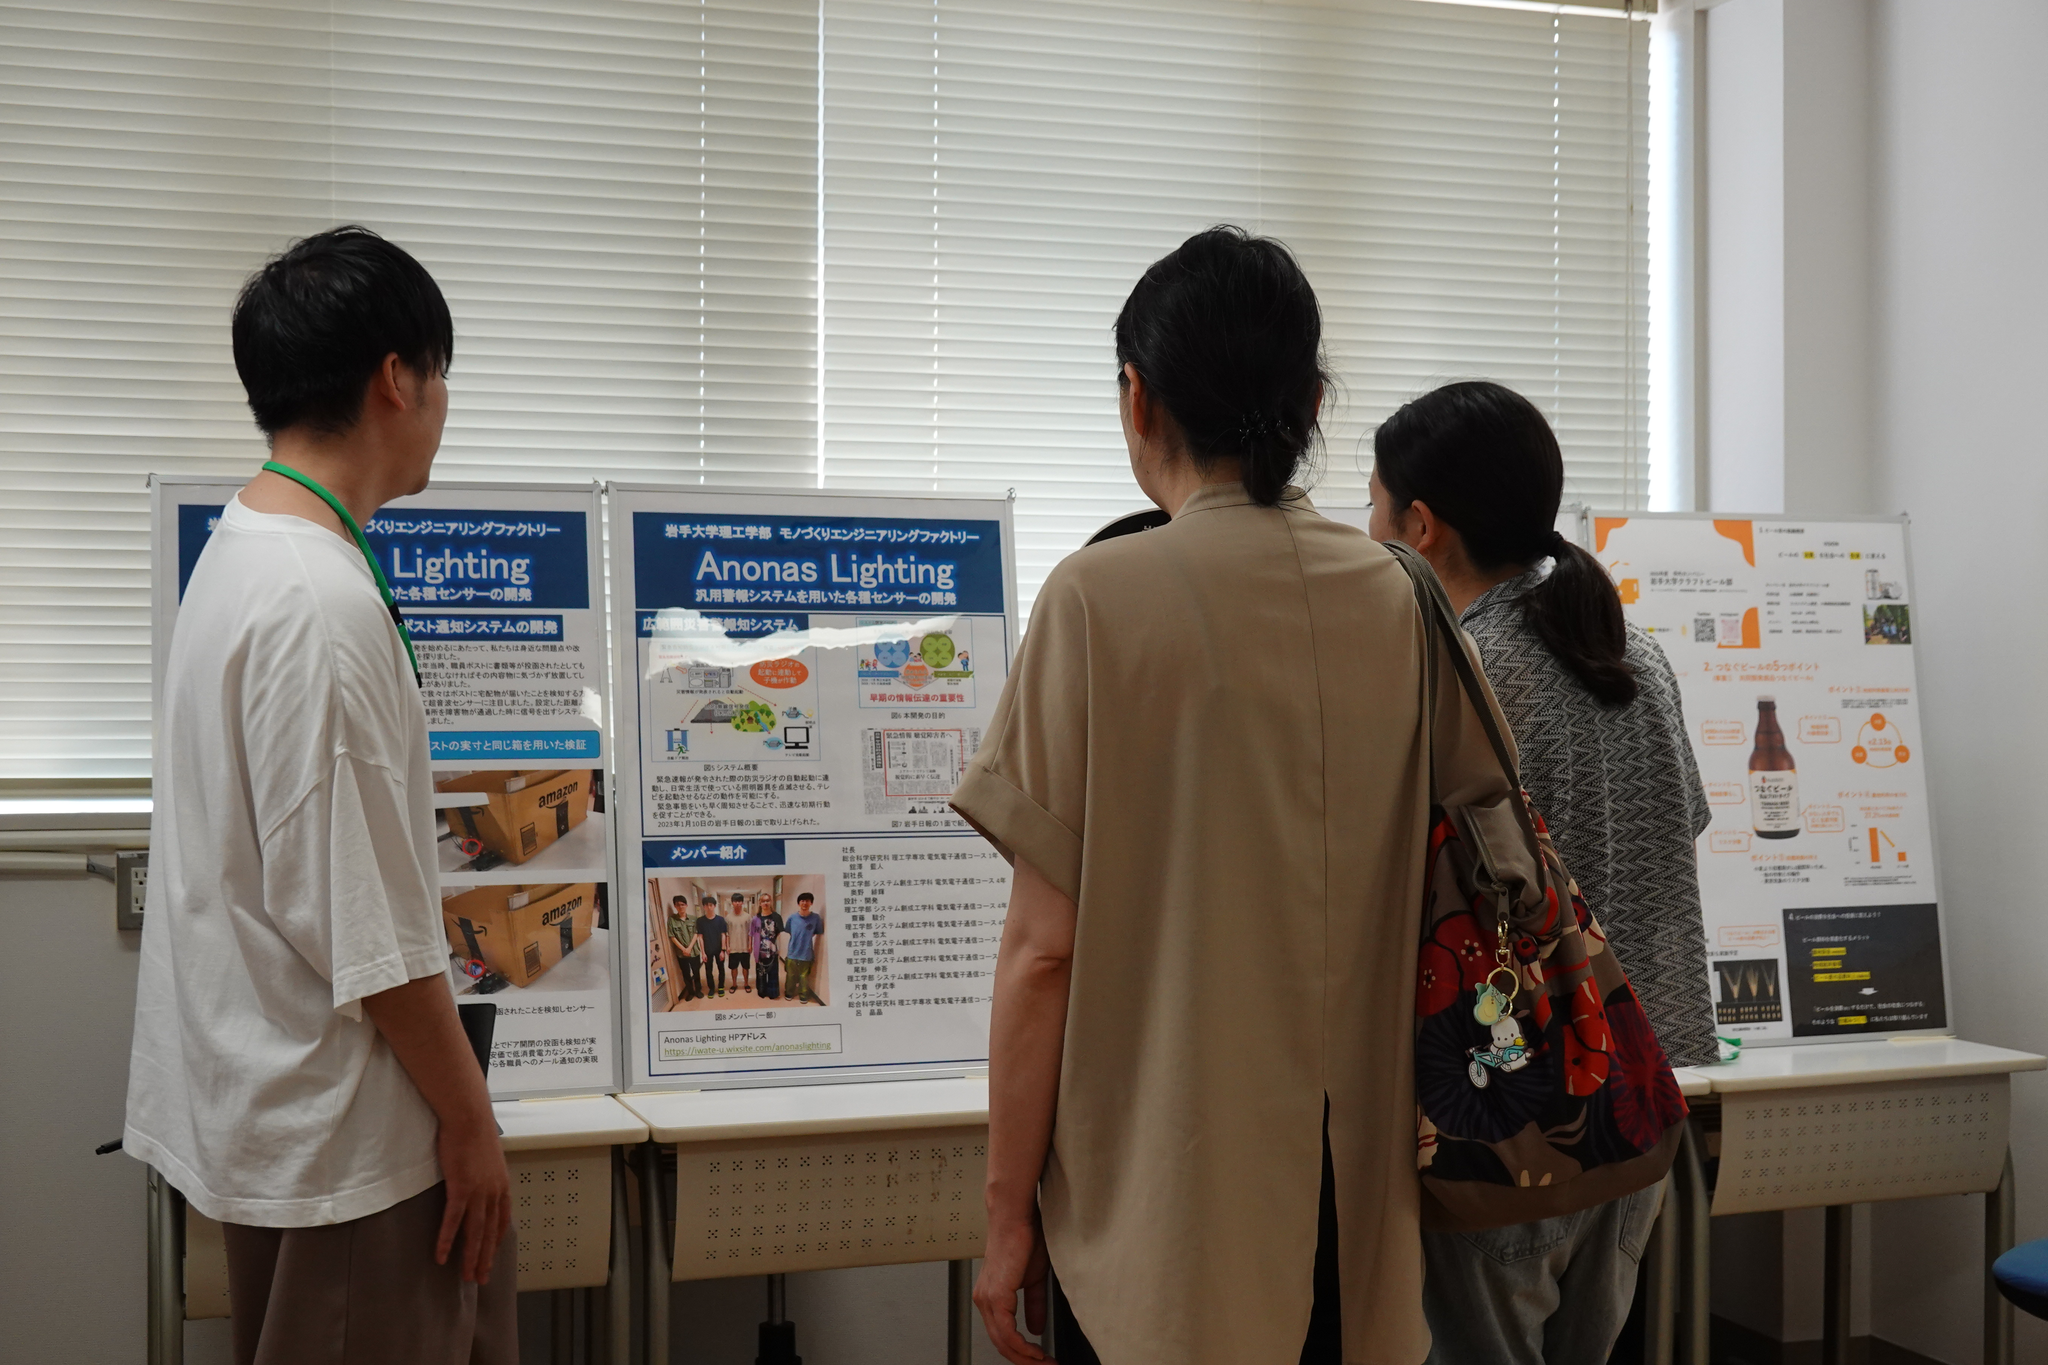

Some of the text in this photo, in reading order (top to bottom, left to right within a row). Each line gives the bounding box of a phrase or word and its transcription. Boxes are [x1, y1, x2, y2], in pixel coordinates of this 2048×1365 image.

[665, 524, 979, 544] 岩手大学理工学部 モノづくりエンジニアリングファクトリー
[393, 547, 530, 585] Lighting
[696, 551, 954, 589] Anonas Lighting
[695, 588, 957, 606] 汎用警報システムを用いた各種センサーの開発
[870, 693, 965, 703] 早期の情報伝達の重要性
[428, 717, 454, 725] ました。
[904, 712, 945, 720] 本開発の目的
[717, 763, 758, 771] システム概要
[538, 780, 578, 808] amazon
[652, 810, 716, 819] を促すことができる。
[671, 845, 747, 860] メンバー紹介
[842, 846, 855, 854] 社長
[927, 852, 987, 861] 電気電子通信コース
[843, 880, 871, 888] 理工学部
[935, 877, 995, 886] 電気電子通信コース
[844, 897, 878, 905] 設計・開発
[542, 895, 583, 926] amazon
[936, 903, 996, 911] 電気電子通信コース
[845, 923, 873, 931] 理工学部
[937, 920, 997, 928] 電気電子通信コース
[846, 940, 873, 948] 理工学部
[937, 937, 997, 945] 電気電子通信コース
[846, 957, 874, 965] 理工学部
[847, 974, 875, 982] 理工学部
[715, 1013, 727, 1021] 図8
[664, 1033, 767, 1044] Anonas Lighting HPアドレス
[664, 1042, 831, 1057] https://iwate-u.wixsite.com/anonaslighting
[489, 1055, 598, 1068] ら各職員へのメール通知の実現
